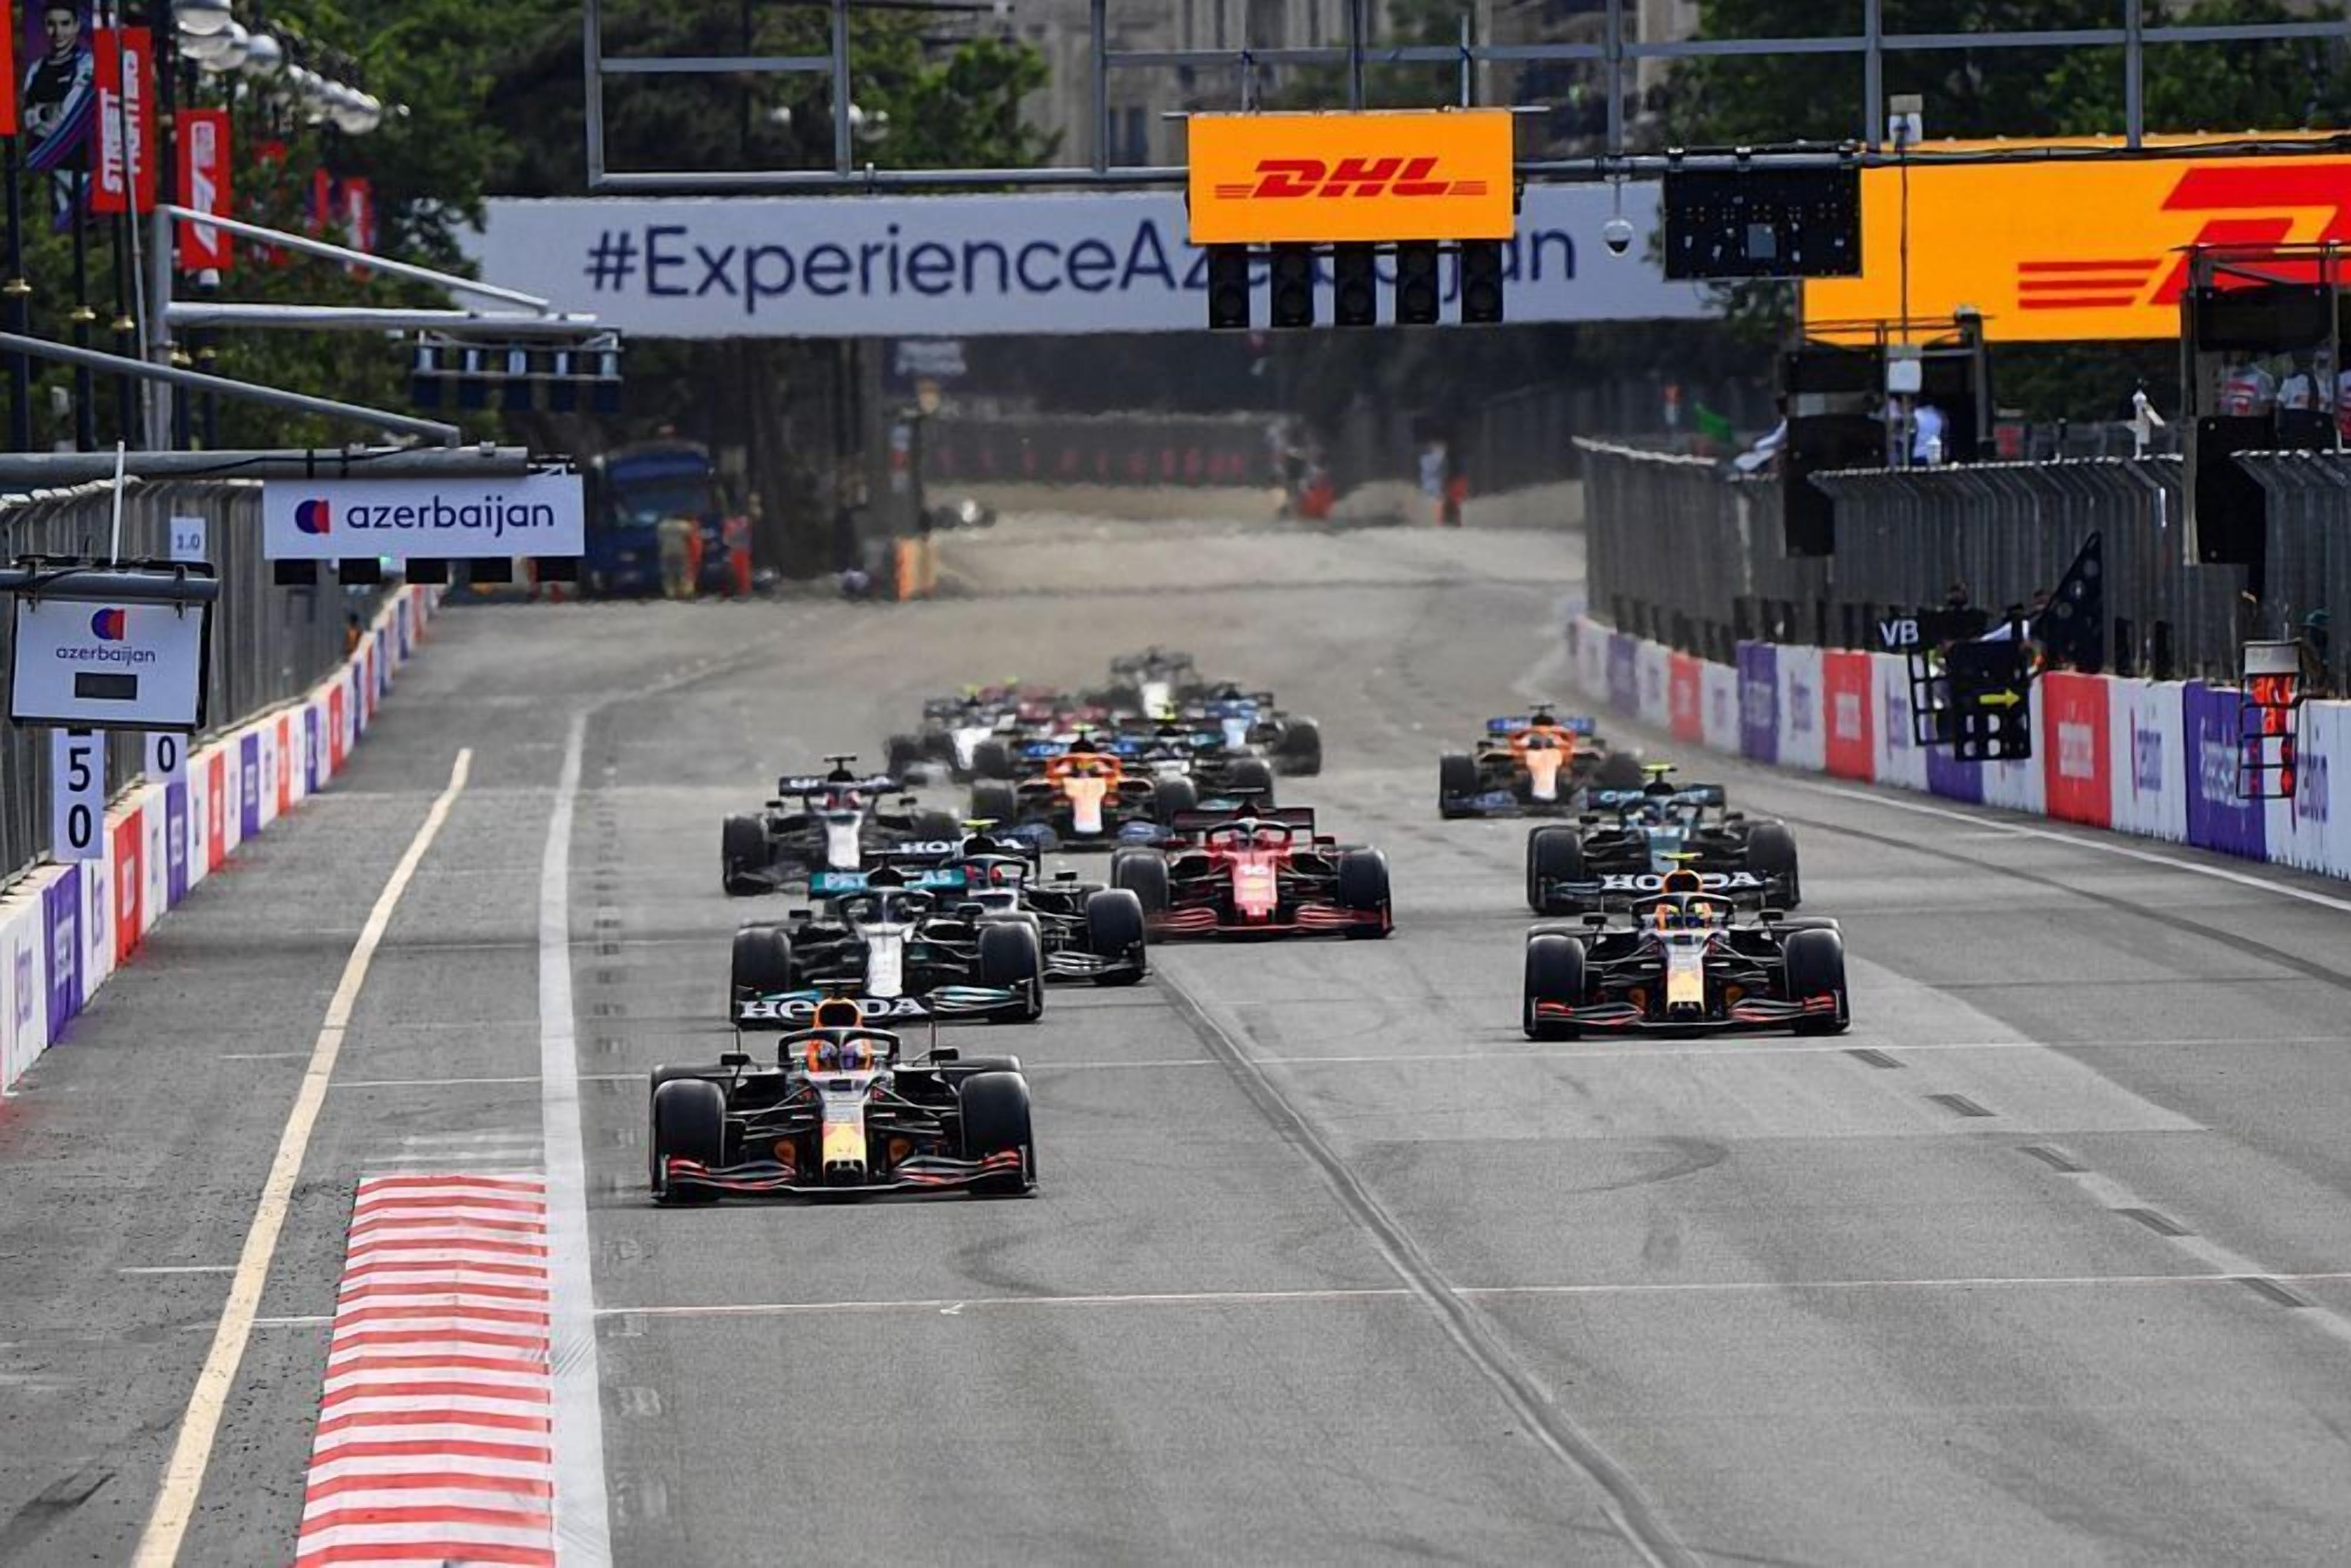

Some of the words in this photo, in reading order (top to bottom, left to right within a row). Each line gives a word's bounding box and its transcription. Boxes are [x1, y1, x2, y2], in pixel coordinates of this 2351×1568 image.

[1252, 157, 1438, 197] DHL
[584, 218, 1576, 316] #ExperienceAzjn
[347, 495, 554, 537] azerbaijan
[1880, 619, 1918, 646] VB
[56, 645, 156, 666] azerbaijan
[1599, 872, 1763, 890] HODA
[739, 998, 929, 1018] HODA
